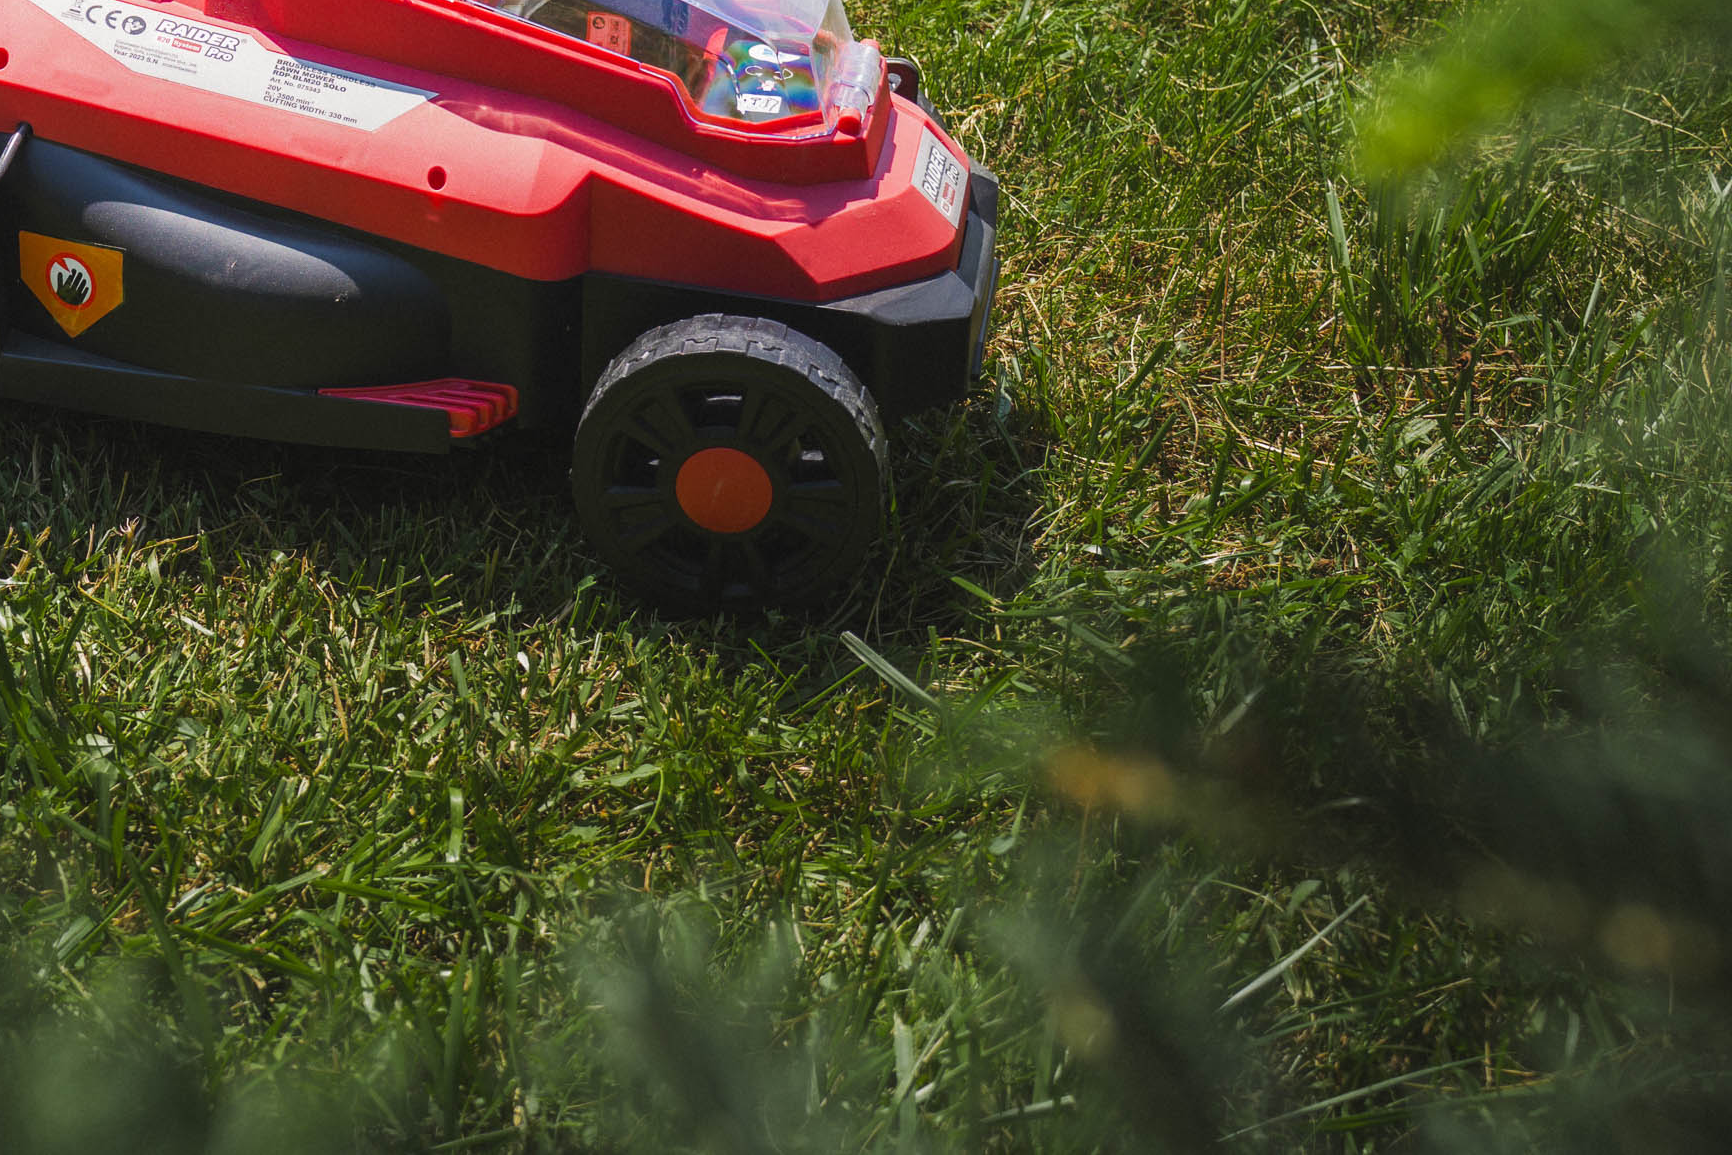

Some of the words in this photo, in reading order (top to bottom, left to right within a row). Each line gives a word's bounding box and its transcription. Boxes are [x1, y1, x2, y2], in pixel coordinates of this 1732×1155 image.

[155, 18, 241, 51] RAIDER
[204, 45, 234, 62] Pro
[272, 69, 321, 86] RDP-BLM20
[323, 82, 347, 92] SOLO
[274, 64, 300, 75] LAWN
[301, 71, 335, 84] MOWER
[276, 58, 329, 77] BRUSHLESS
[330, 72, 377, 88] CORDLESS
[267, 84, 282, 92] 20V
[263, 95, 298, 108] CUTTING
[299, 104, 327, 116] WIDTH:
[343, 116, 358, 124] mm
[921, 145, 947, 203] RAIDER
[946, 162, 960, 186] Pro
